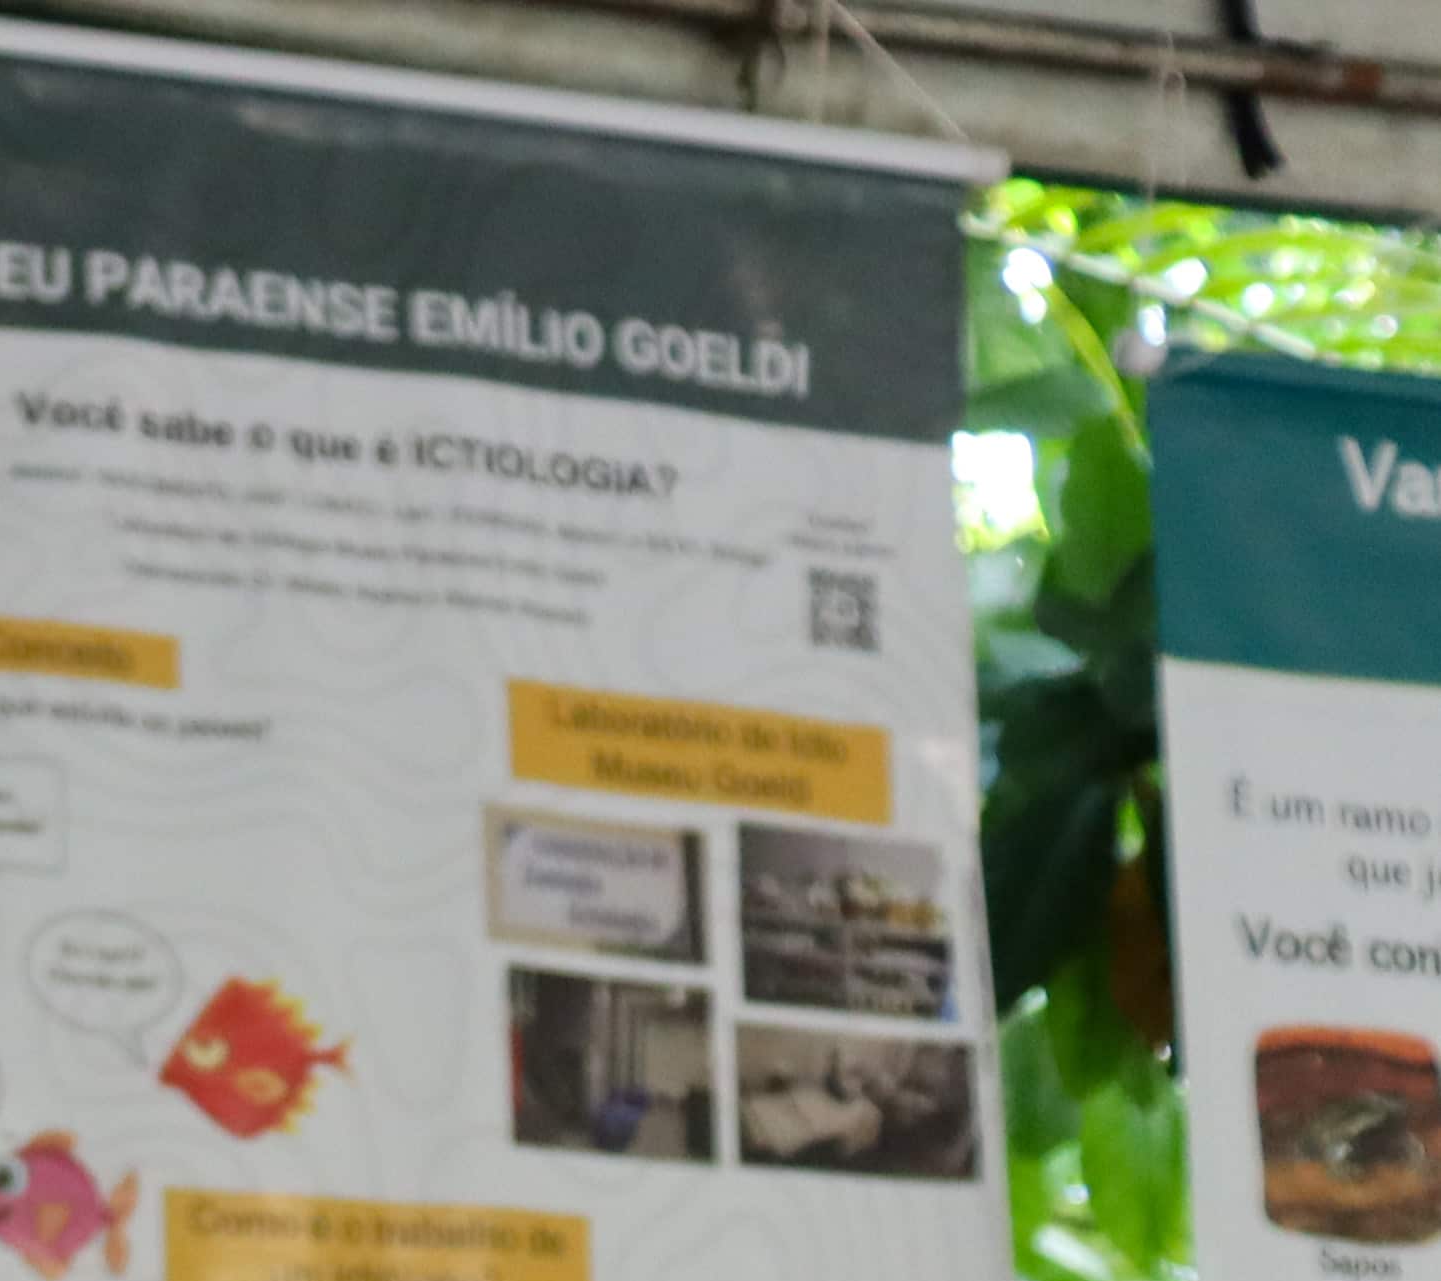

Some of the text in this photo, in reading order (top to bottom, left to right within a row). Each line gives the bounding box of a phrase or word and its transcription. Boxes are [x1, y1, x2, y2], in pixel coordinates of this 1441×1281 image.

[86, 252, 398, 342] PARAENSE
[410, 289, 605, 369] EMÍLIO
[612, 318, 810, 398] GOELDI
[16, 388, 679, 498] Você sabe o que é ICTIOLOGIA?
[1271, 796, 1326, 824] um
[1338, 802, 1432, 837] ramo
[1346, 854, 1411, 892] que
[1236, 911, 1354, 966] Você
